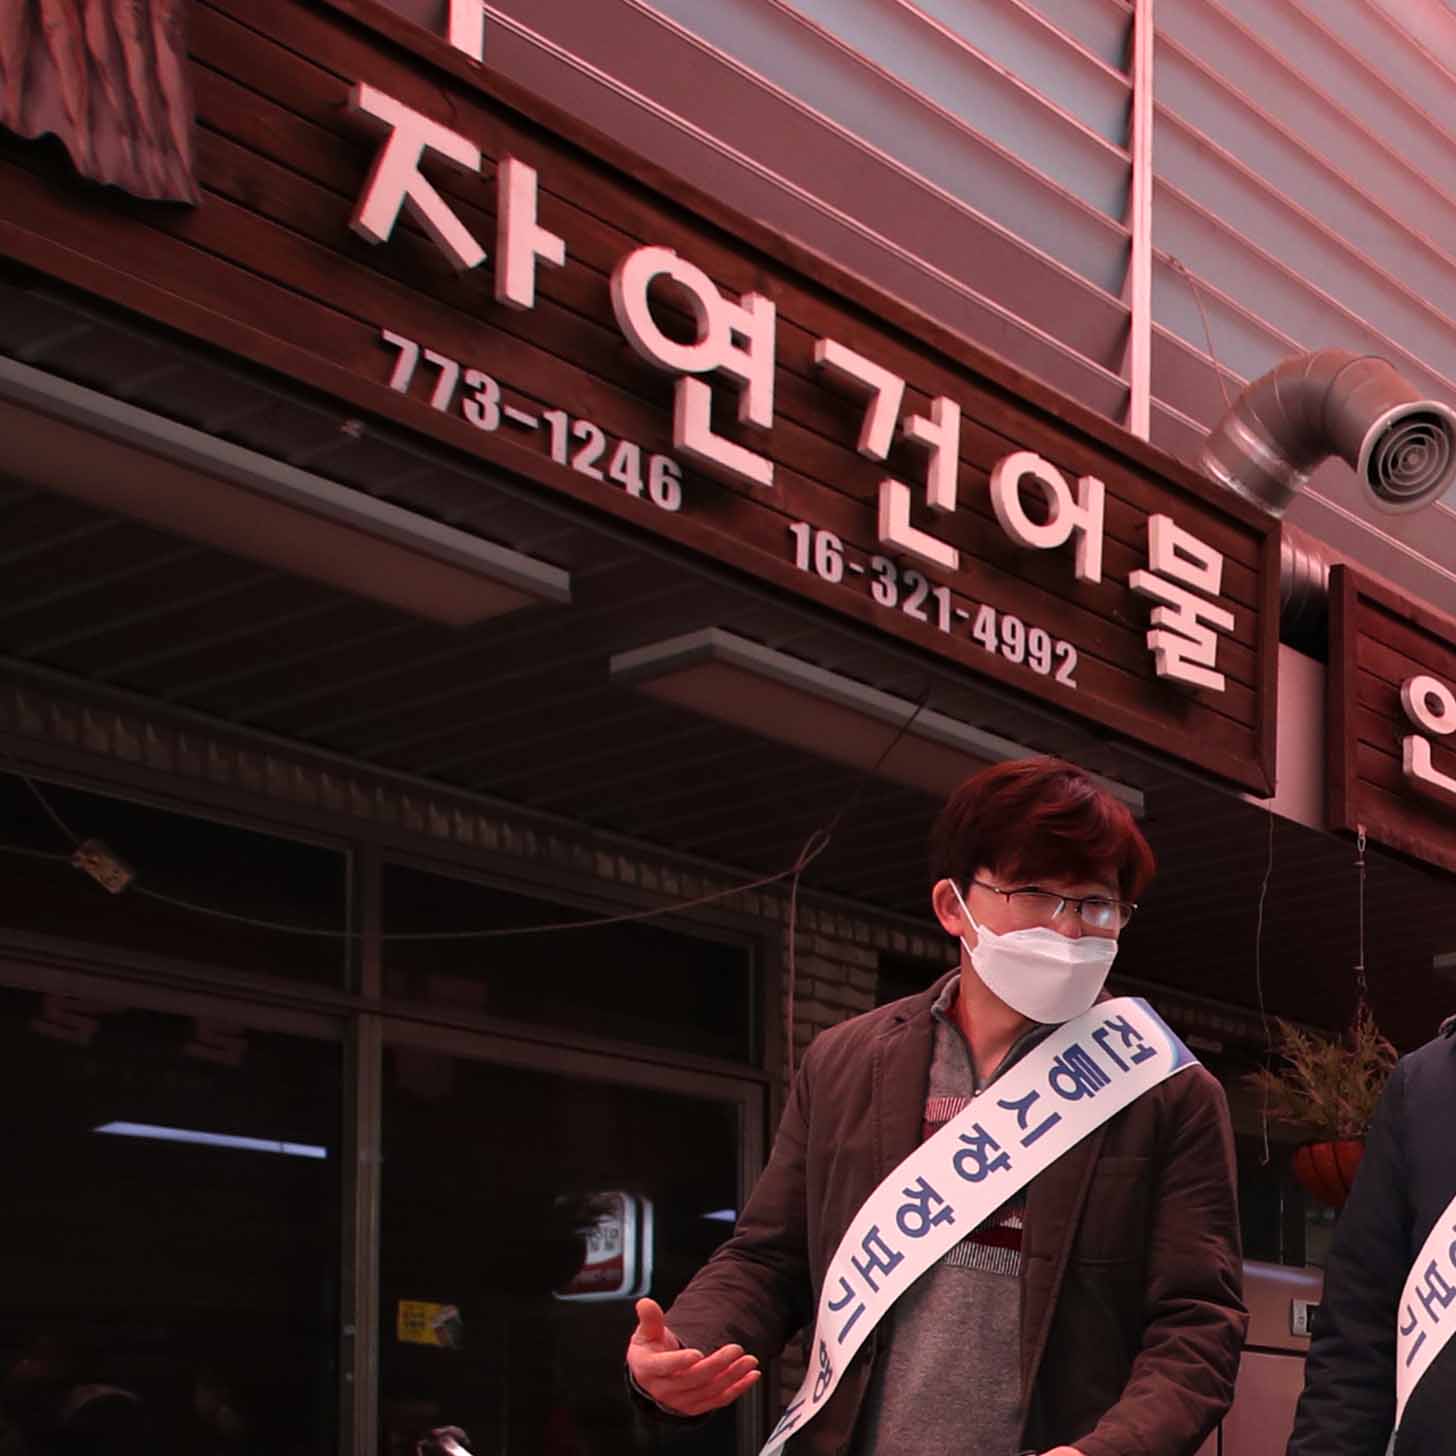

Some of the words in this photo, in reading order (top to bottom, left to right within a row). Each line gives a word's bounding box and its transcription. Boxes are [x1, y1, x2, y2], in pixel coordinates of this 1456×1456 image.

[347, 81, 1238, 693] 자연건어물
[380, 329, 684, 514] 773-1246
[790, 522, 1079, 689] 16-321-4992
[951, 1012, 1157, 1186] 전통시장
[828, 1176, 956, 1345] 장보기
